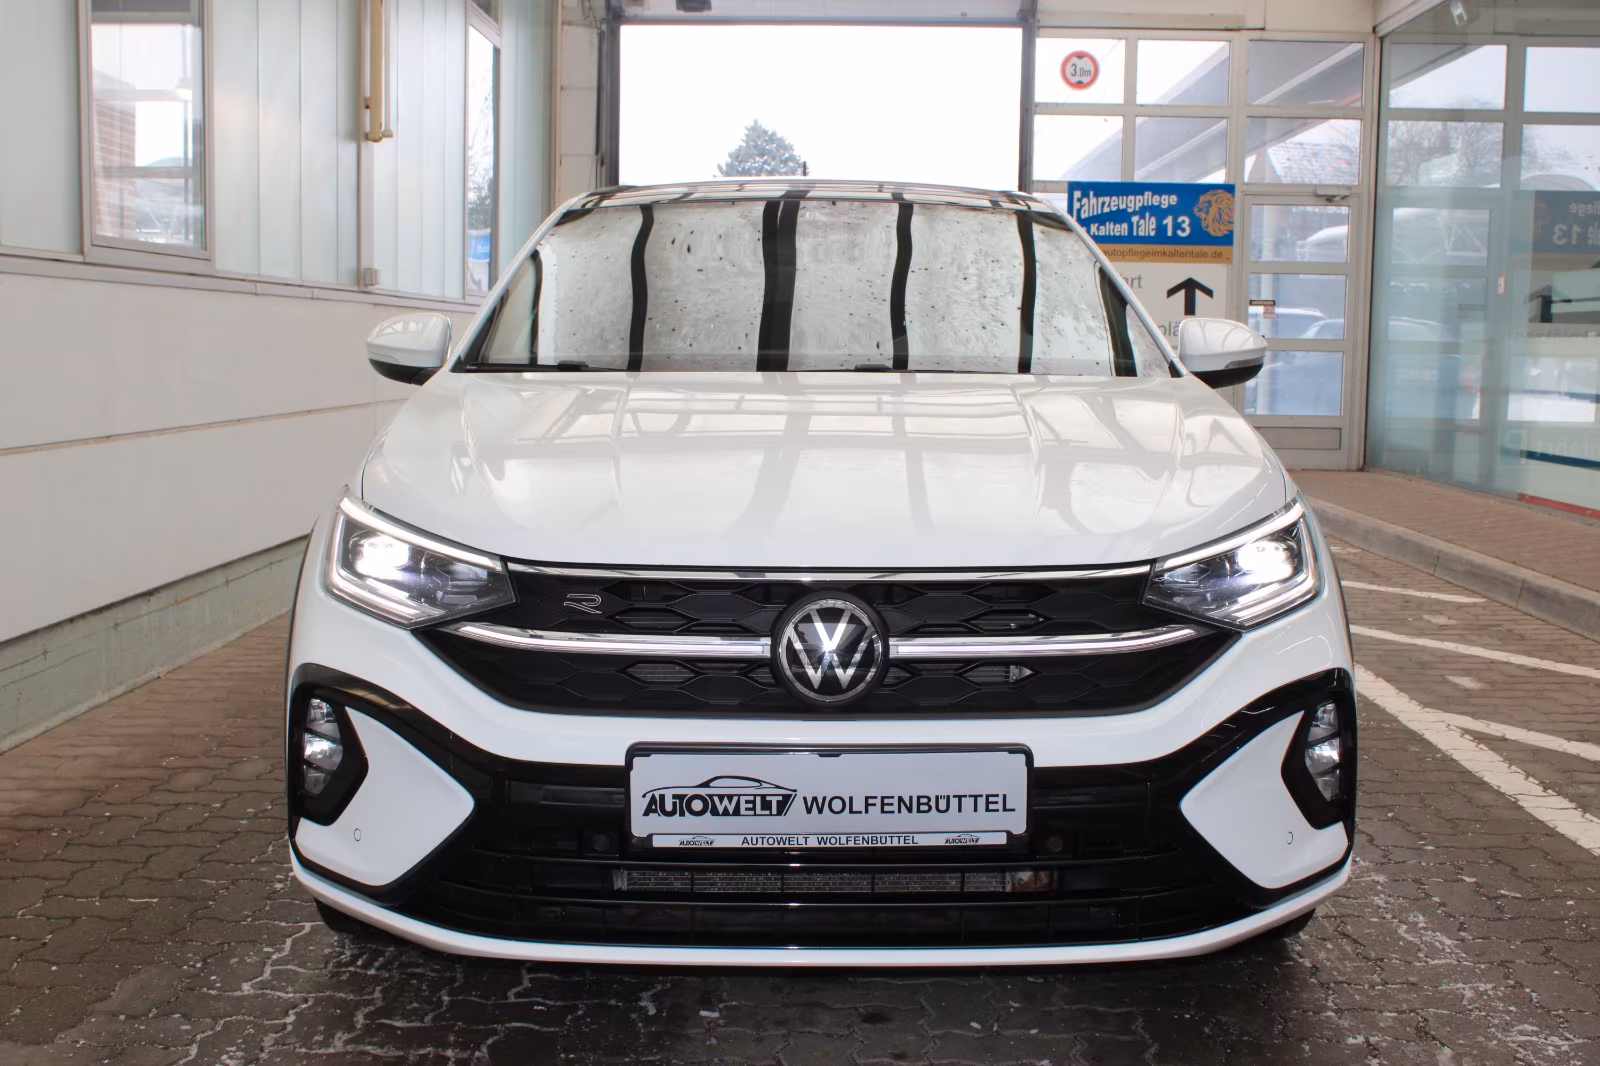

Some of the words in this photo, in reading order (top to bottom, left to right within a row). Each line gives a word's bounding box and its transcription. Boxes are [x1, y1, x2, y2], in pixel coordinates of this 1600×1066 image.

[1073, 190, 1178, 221] Fahrzeugpflege
[1090, 221, 1128, 236] Kalten
[1131, 212, 1156, 236] Tale
[1162, 215, 1191, 237] 13
[642, 793, 797, 818] AUTOWELT
[803, 794, 1016, 815] WOLFENBÜTTEL
[741, 836, 811, 846] AUTOWELT
[816, 835, 919, 846] WOLFENBÜTTEL
